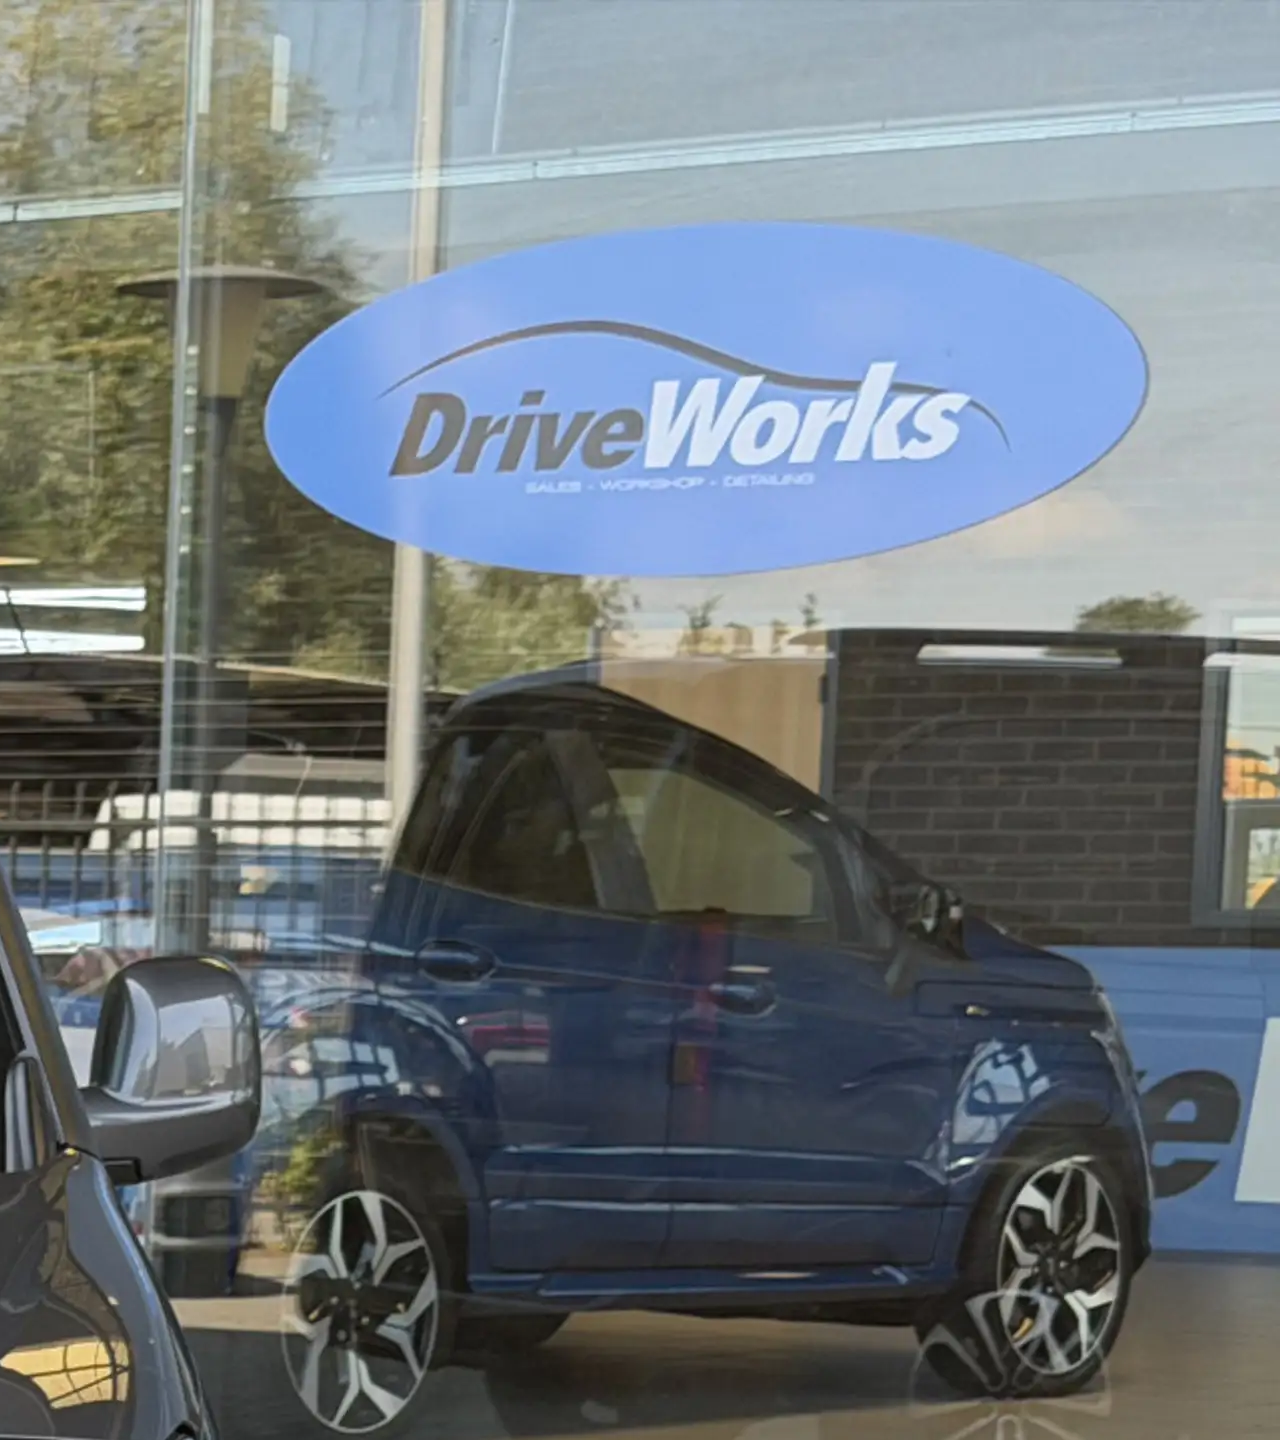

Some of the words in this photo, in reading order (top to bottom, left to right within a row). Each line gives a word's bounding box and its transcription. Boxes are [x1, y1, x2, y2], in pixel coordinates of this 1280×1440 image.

[388, 361, 971, 478] DriveWorks
[525, 480, 582, 494] SALES
[600, 476, 705, 492] WORKSHOP
[723, 472, 815, 488] DETAILING
